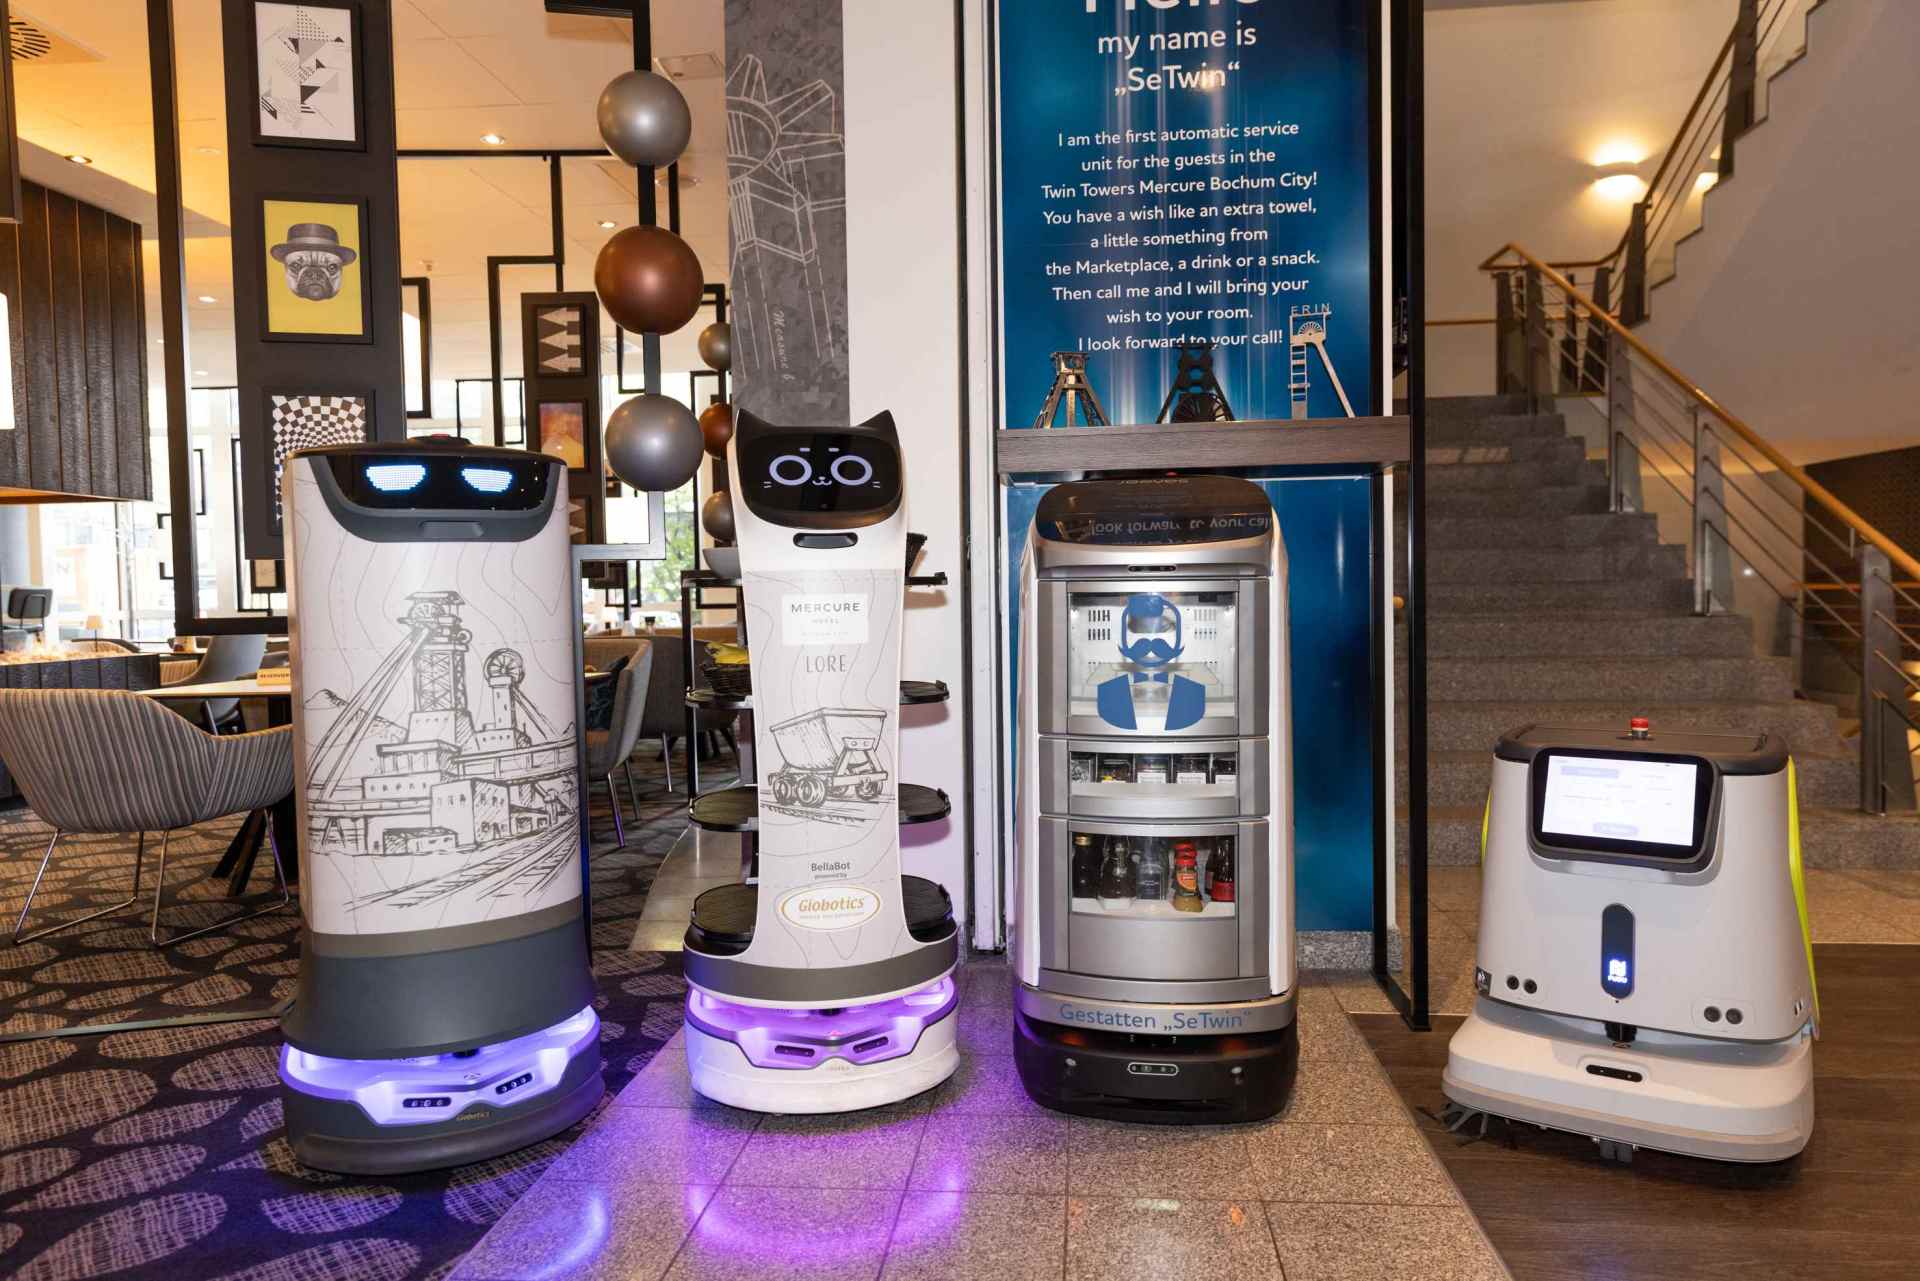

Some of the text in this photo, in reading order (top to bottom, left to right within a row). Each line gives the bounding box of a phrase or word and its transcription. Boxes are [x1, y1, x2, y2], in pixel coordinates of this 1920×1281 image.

[1098, 20, 1257, 61] my name is
[1059, 121, 1299, 146] I am the first automatic service
[1082, 148, 1276, 171] unit for the guests in the
[1041, 171, 1317, 199] Twin Towers Mercure Bochum City!
[1043, 198, 1316, 224] You have a wish like an extra towel,
[1091, 228, 1268, 248] a little something from
[1046, 250, 1320, 276] the Marketplace, a drink or a snack.
[1052, 277, 1309, 300] Then call me and I will bring your
[1107, 309, 1253, 325] wish to your room.
[1291, 303, 1331, 316] ERIN
[1079, 338, 1083, 352] I
[1088, 337, 1120, 351] look
[1125, 333, 1185, 349] forward
[1211, 334, 1247, 350] your
[1252, 329, 1283, 345] call!
[791, 602, 861, 613] MERCURE
[806, 654, 846, 673] LORE
[811, 861, 850, 872] BellaBot
[799, 896, 865, 913] Globotics
[1059, 1003, 1156, 1028] Gestatten
